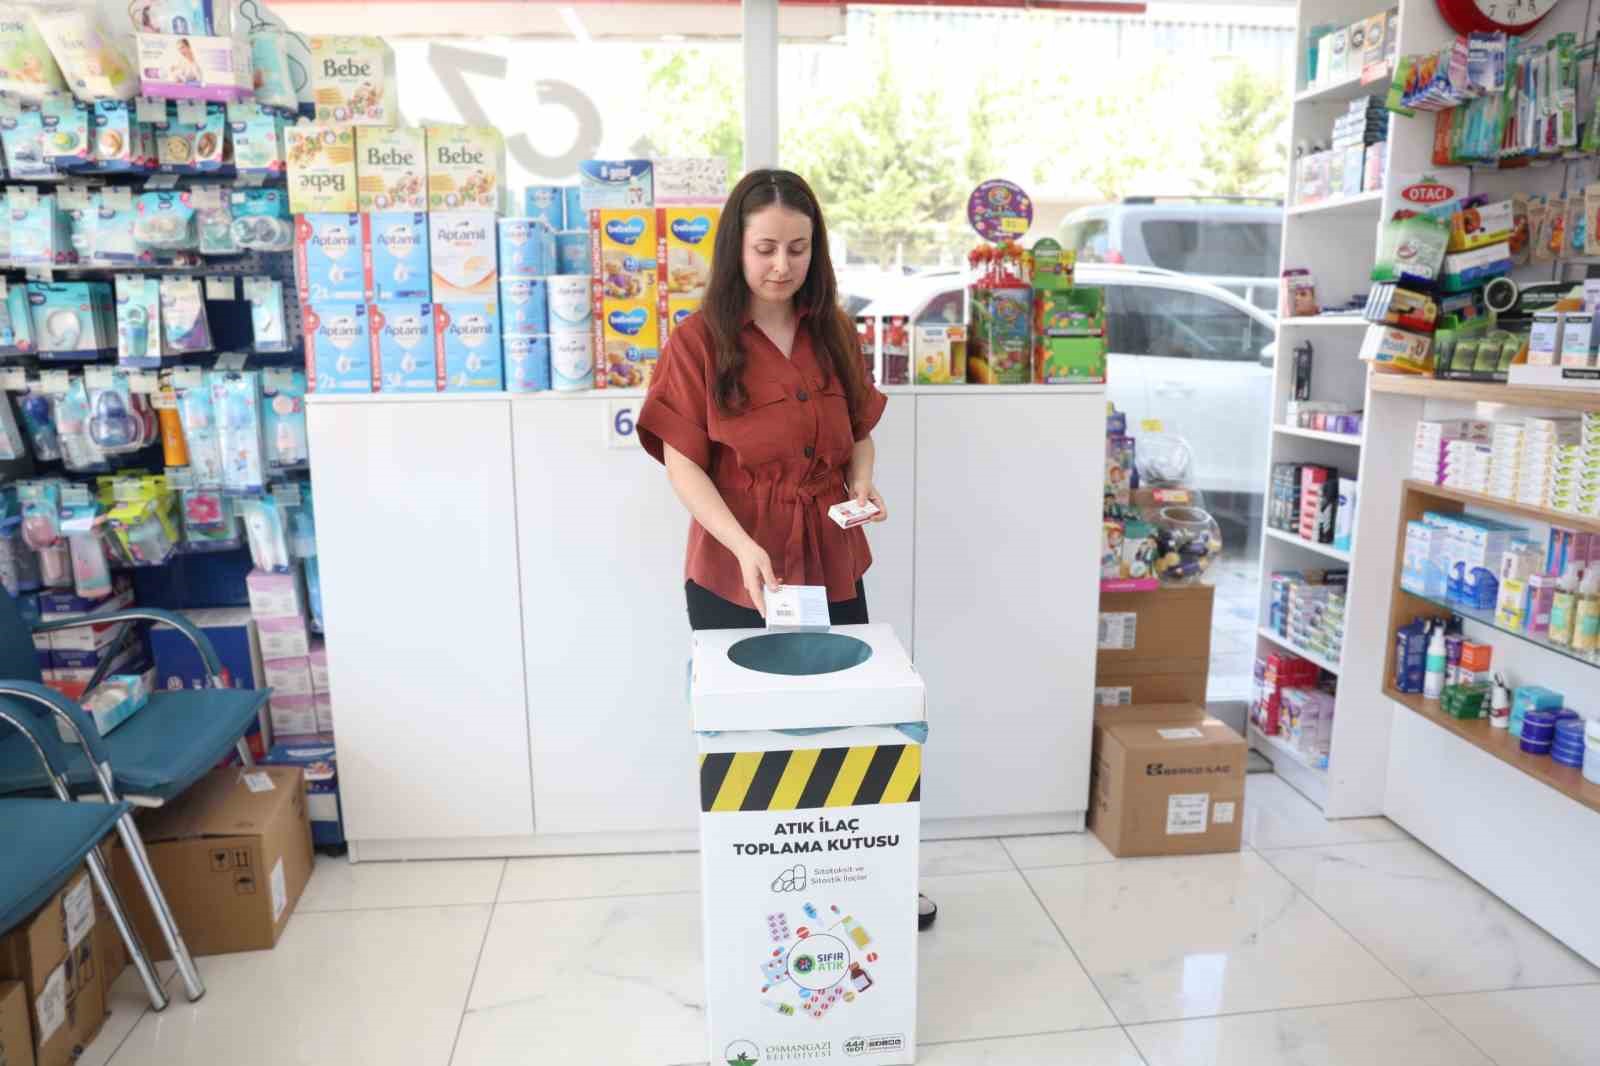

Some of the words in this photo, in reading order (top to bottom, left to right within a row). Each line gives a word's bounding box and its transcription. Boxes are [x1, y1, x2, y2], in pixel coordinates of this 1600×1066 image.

[323, 58, 371, 77] Bebe
[367, 147, 416, 165] Bebe
[437, 146, 484, 165] Bebe
[298, 174, 346, 192] Bebe
[312, 235, 356, 247] Aptamil
[377, 234, 421, 245] Aptamil
[438, 229, 485, 241] Aptamil
[319, 325, 363, 336] Aptamil
[385, 325, 429, 336] Aptamil
[449, 324, 493, 335] Aptamil
[614, 408, 634, 436] 6
[774, 821, 815, 836] ATIK
[819, 816, 860, 834] İLAÇ
[733, 840, 823, 856] TOPLAMA
[827, 835, 900, 851] KUTUSU
[817, 952, 844, 962] SIFIR
[817, 961, 844, 971] ATIK
